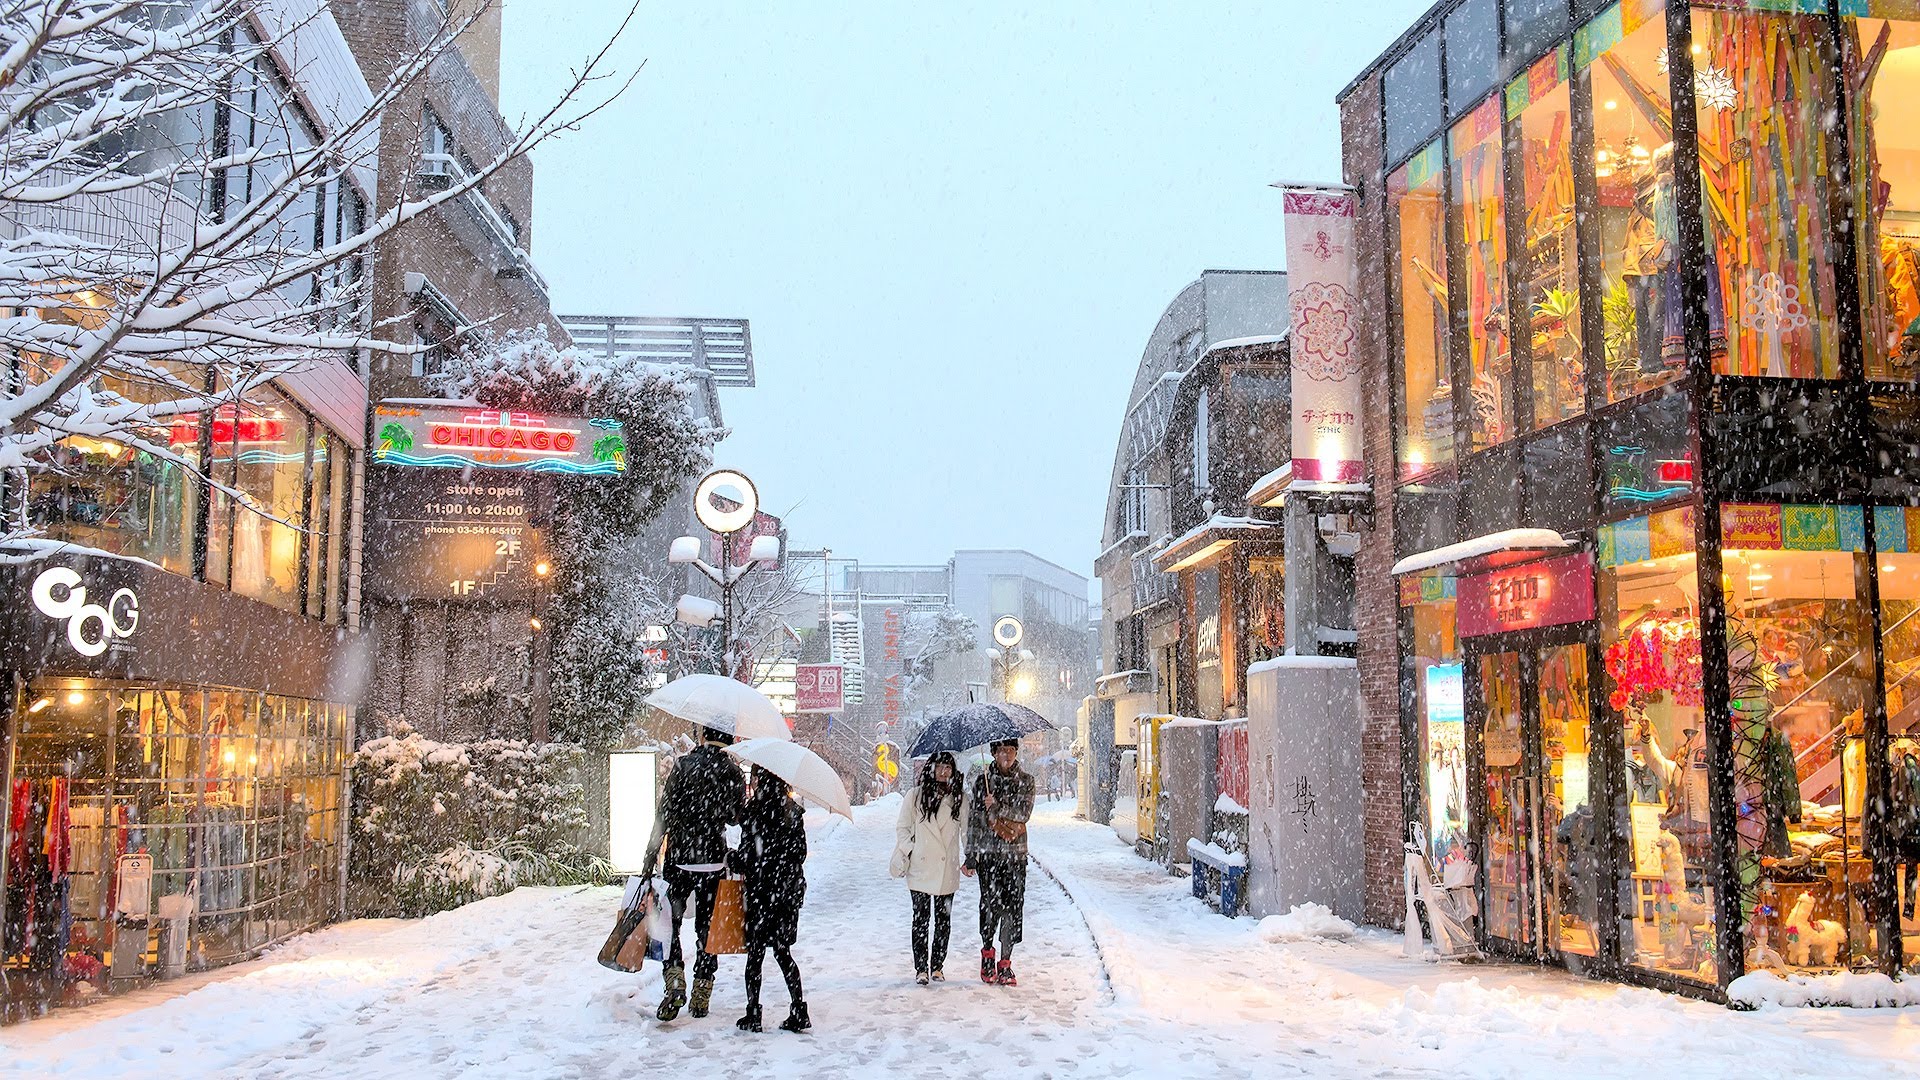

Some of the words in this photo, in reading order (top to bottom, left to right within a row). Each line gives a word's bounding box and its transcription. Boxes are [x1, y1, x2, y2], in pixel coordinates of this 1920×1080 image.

[1302, 409, 1354, 425] チチカカ
[431, 425, 576, 451] CHICAGO
[446, 486, 484, 496] store
[487, 487, 524, 499] open
[425, 503, 463, 514] 11:00
[467, 504, 481, 515] to
[485, 505, 524, 516] 20:00
[425, 525, 455, 535] phone
[457, 526, 523, 536] 03-5414-5107
[495, 541, 522, 554] 2F
[450, 580, 475, 595] 1F
[883, 608, 899, 662] JUNK
[821, 675, 835, 685] 20
[883, 673, 899, 726] YARD
